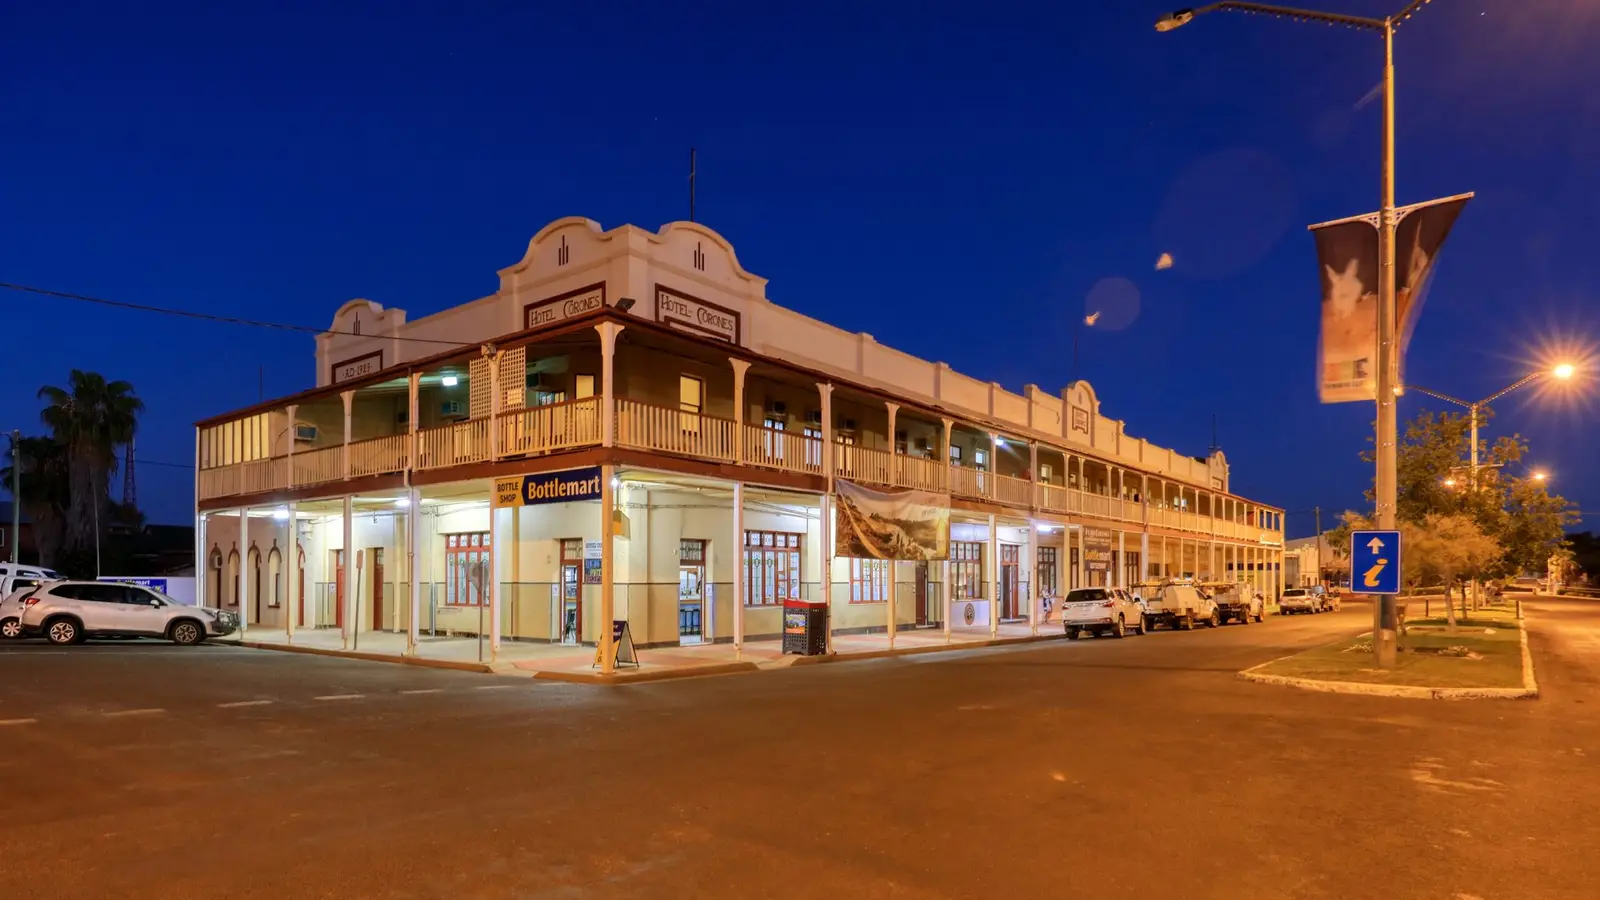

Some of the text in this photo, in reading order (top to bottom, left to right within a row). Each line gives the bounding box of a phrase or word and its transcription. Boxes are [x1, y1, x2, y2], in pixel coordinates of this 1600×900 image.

[531, 295, 600, 325] HOTEL CORONES
[697, 307, 733, 331] CORONES
[497, 482, 519, 492] BOTTLE
[500, 493, 517, 503] SHOP
[528, 475, 600, 500] Bottlemart
